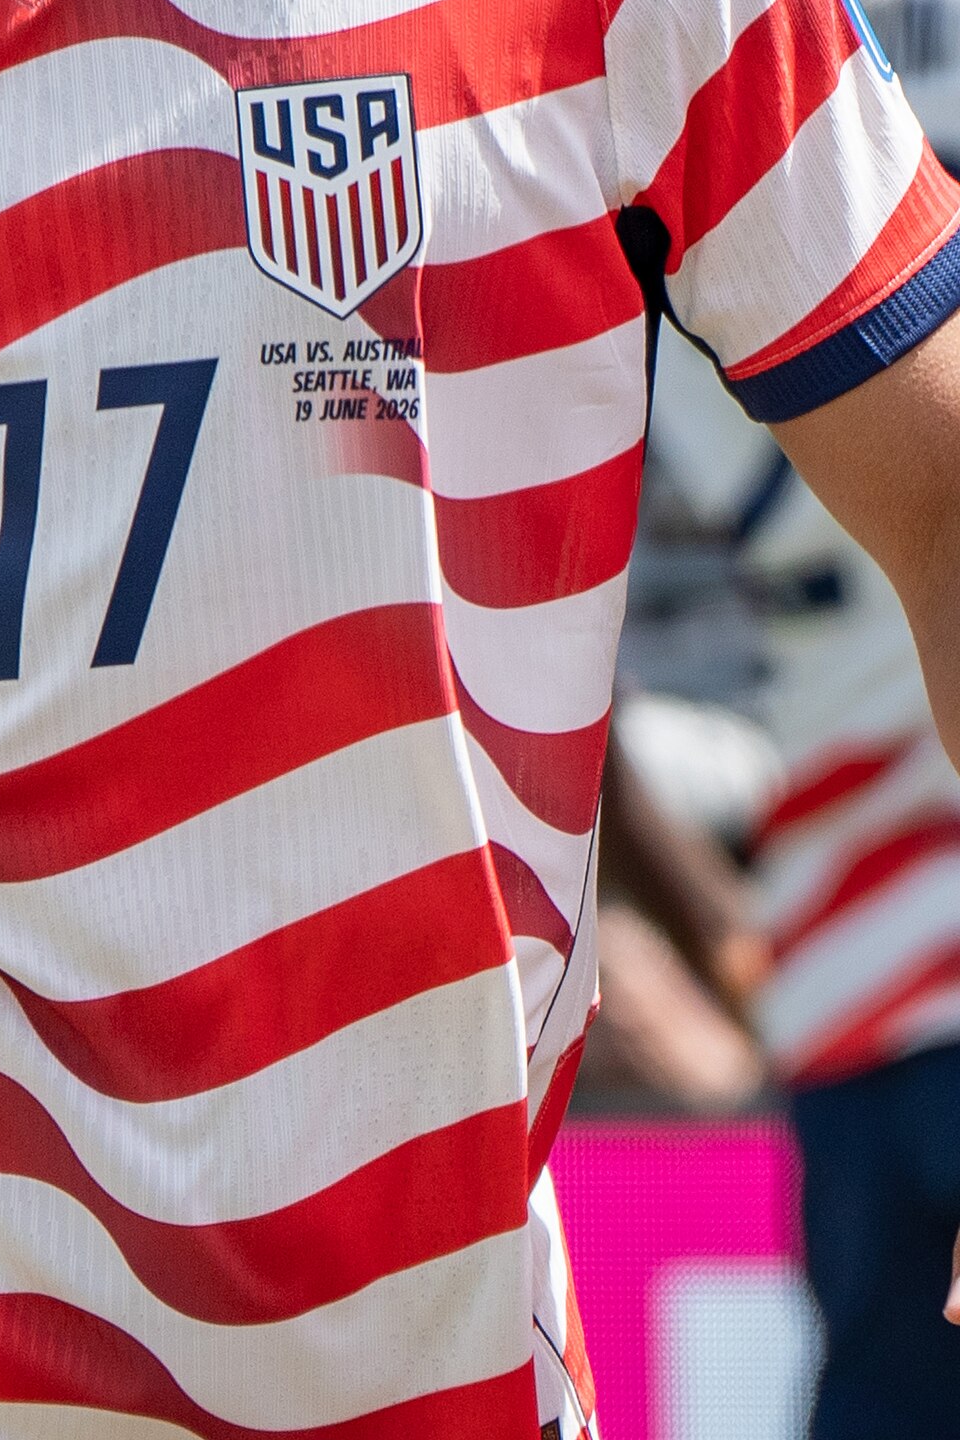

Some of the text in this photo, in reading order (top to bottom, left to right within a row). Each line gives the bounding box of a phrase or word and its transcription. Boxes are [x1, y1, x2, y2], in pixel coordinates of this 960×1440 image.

[250, 89, 400, 180] USA
[260, 342, 296, 364] USA
[307, 340, 334, 362] VS.
[293, 367, 417, 393] SEATTLE, WA
[295, 398, 420, 422] 19 JUNE 2026
